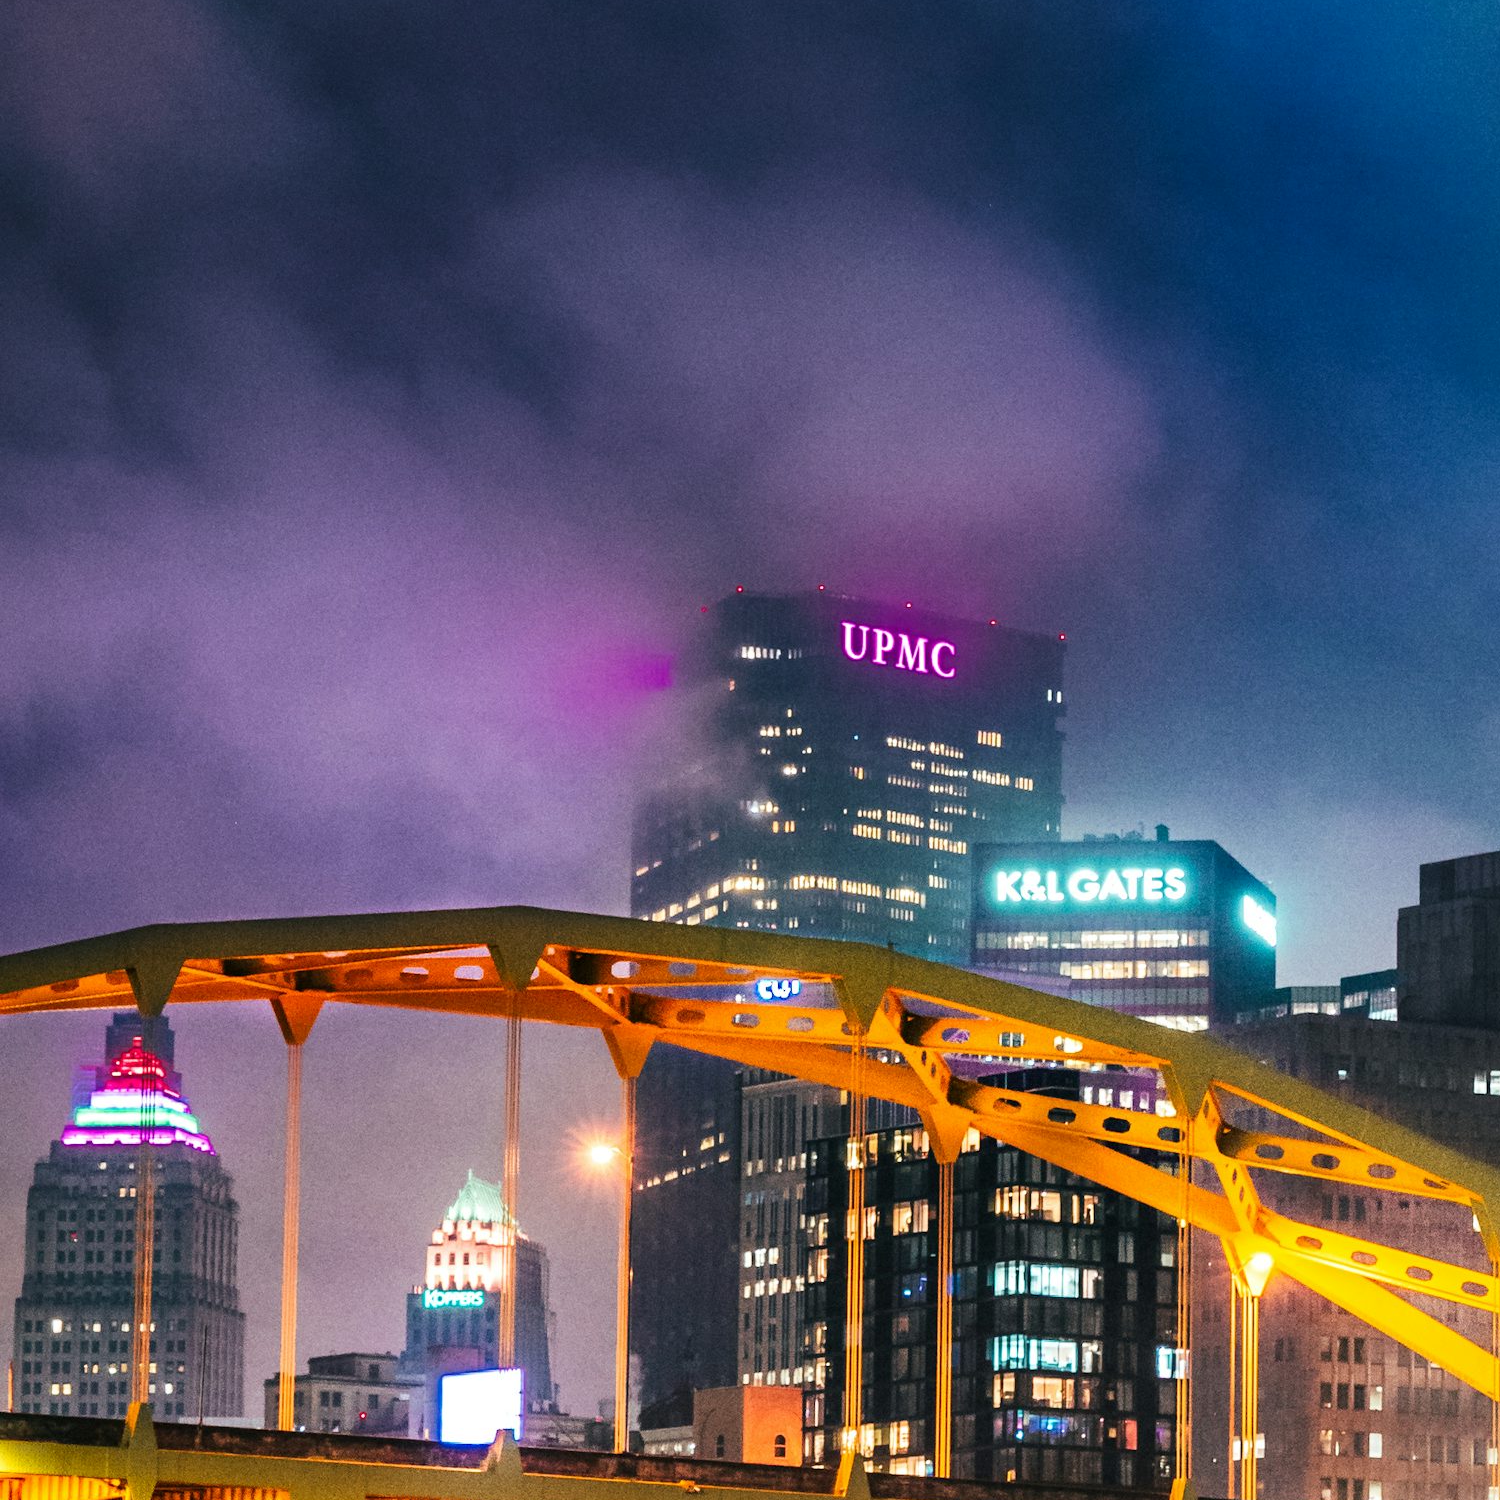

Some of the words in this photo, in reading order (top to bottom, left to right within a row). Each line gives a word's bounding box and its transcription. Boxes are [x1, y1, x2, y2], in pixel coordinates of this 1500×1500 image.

[841, 621, 956, 678] UPMC
[997, 869, 1065, 901] K&L
[1067, 867, 1187, 901] GATES
[424, 1289, 484, 1308] KOPPERS
